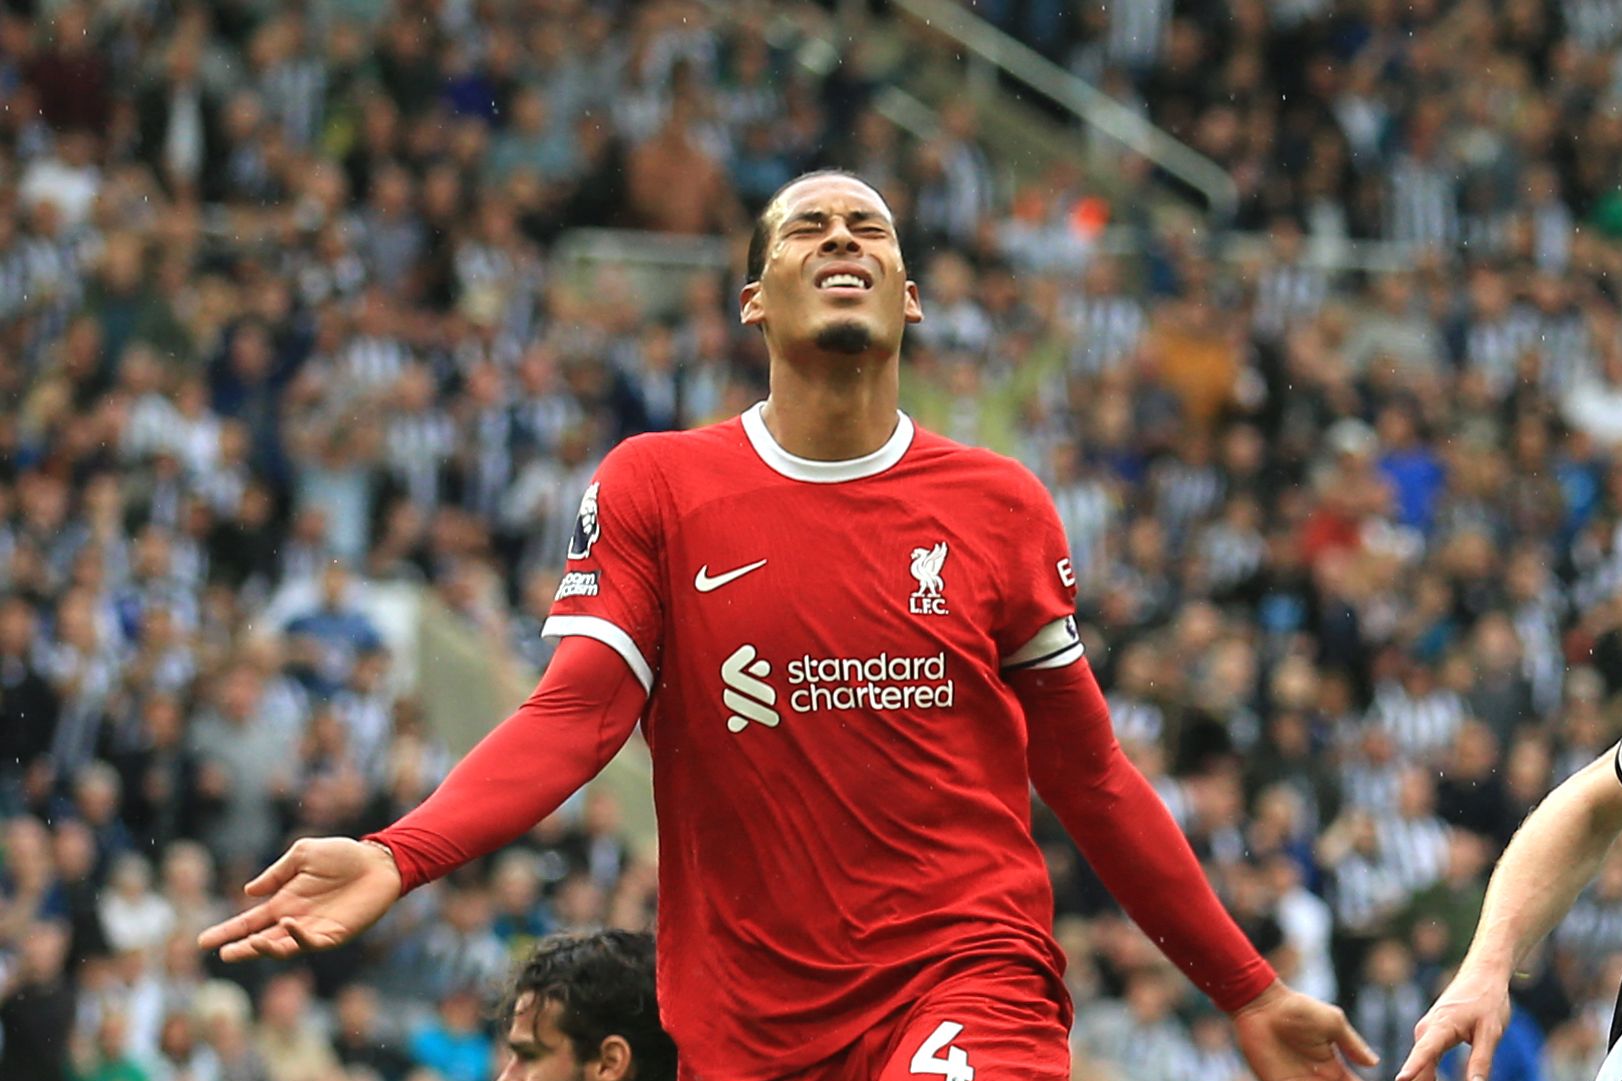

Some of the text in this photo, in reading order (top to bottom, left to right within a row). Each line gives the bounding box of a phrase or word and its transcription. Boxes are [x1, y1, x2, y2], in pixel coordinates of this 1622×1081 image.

[909, 597, 949, 615] L.F.C.
[787, 651, 945, 685] standard
[790, 679, 954, 712] chartered
